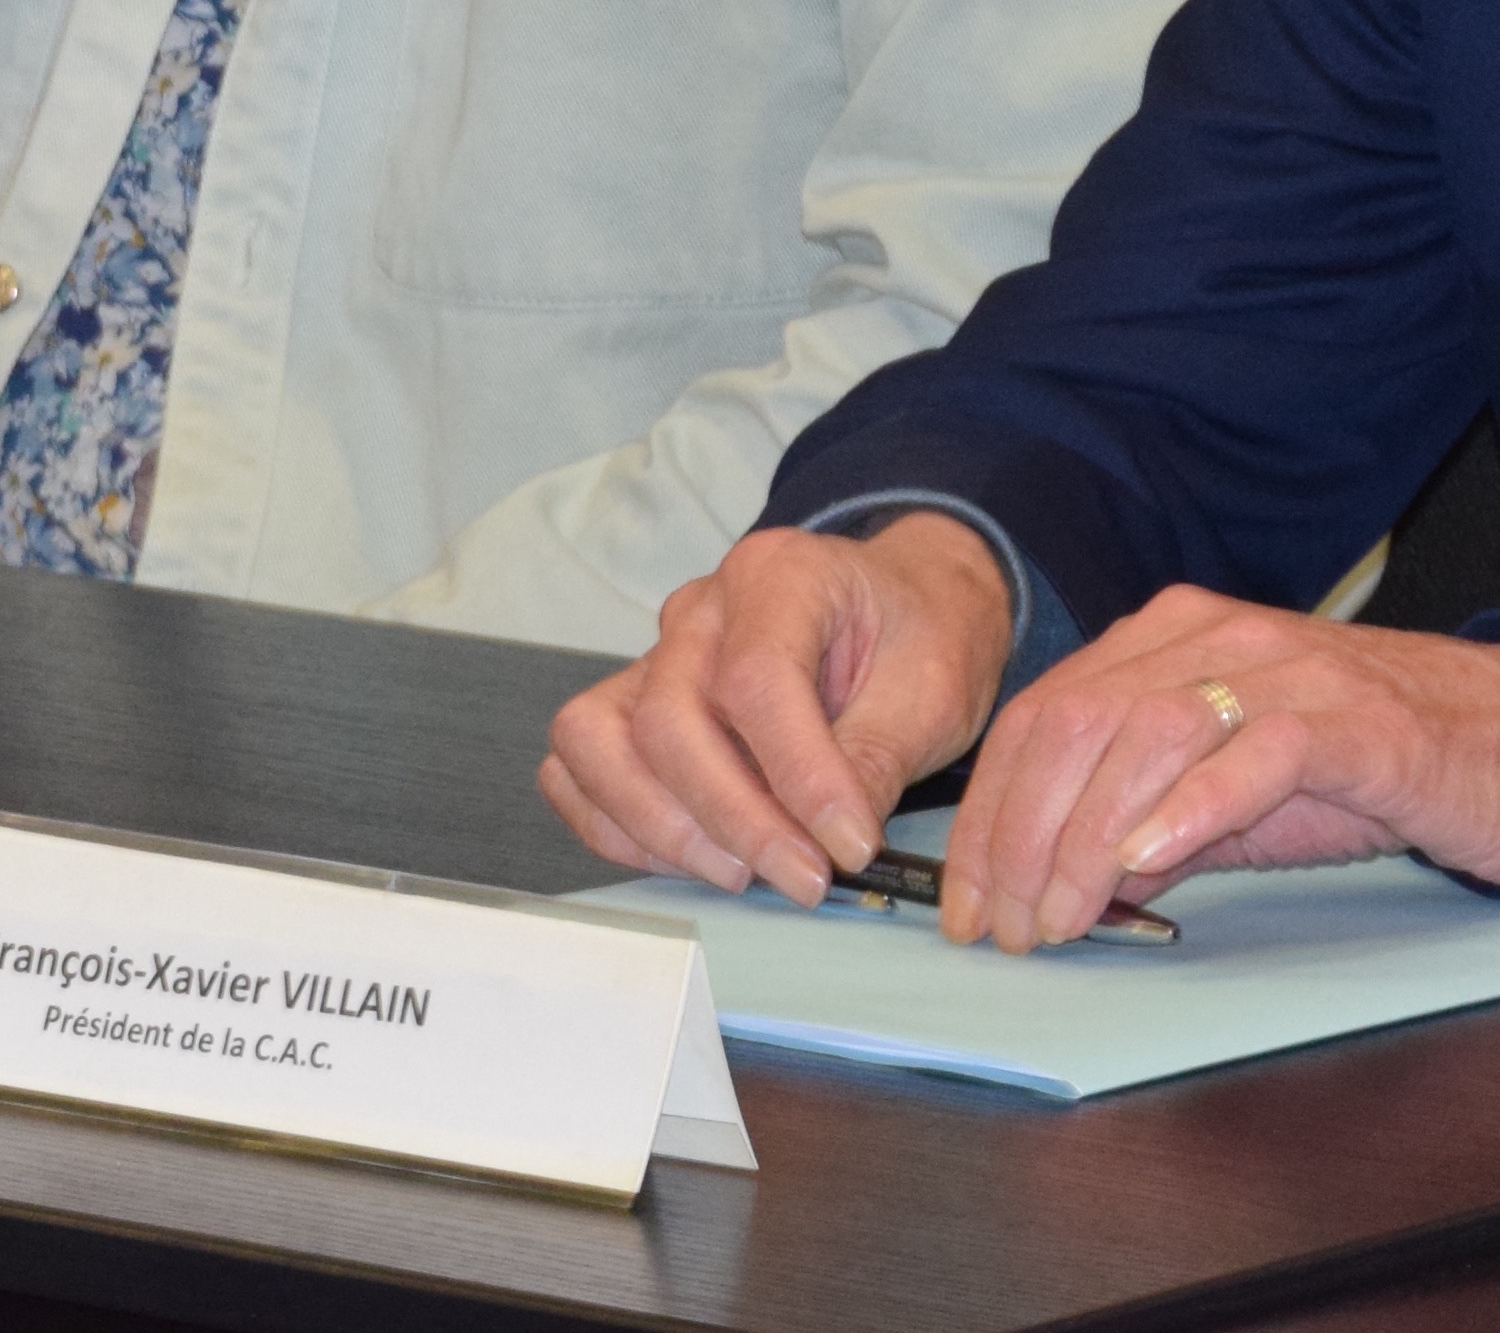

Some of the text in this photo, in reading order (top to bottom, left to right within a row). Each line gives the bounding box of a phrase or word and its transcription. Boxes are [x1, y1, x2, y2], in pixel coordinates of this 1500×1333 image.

[282, 969, 432, 1028] VILLAIN
[42, 1004, 334, 1071] Président de la C.A.C.
